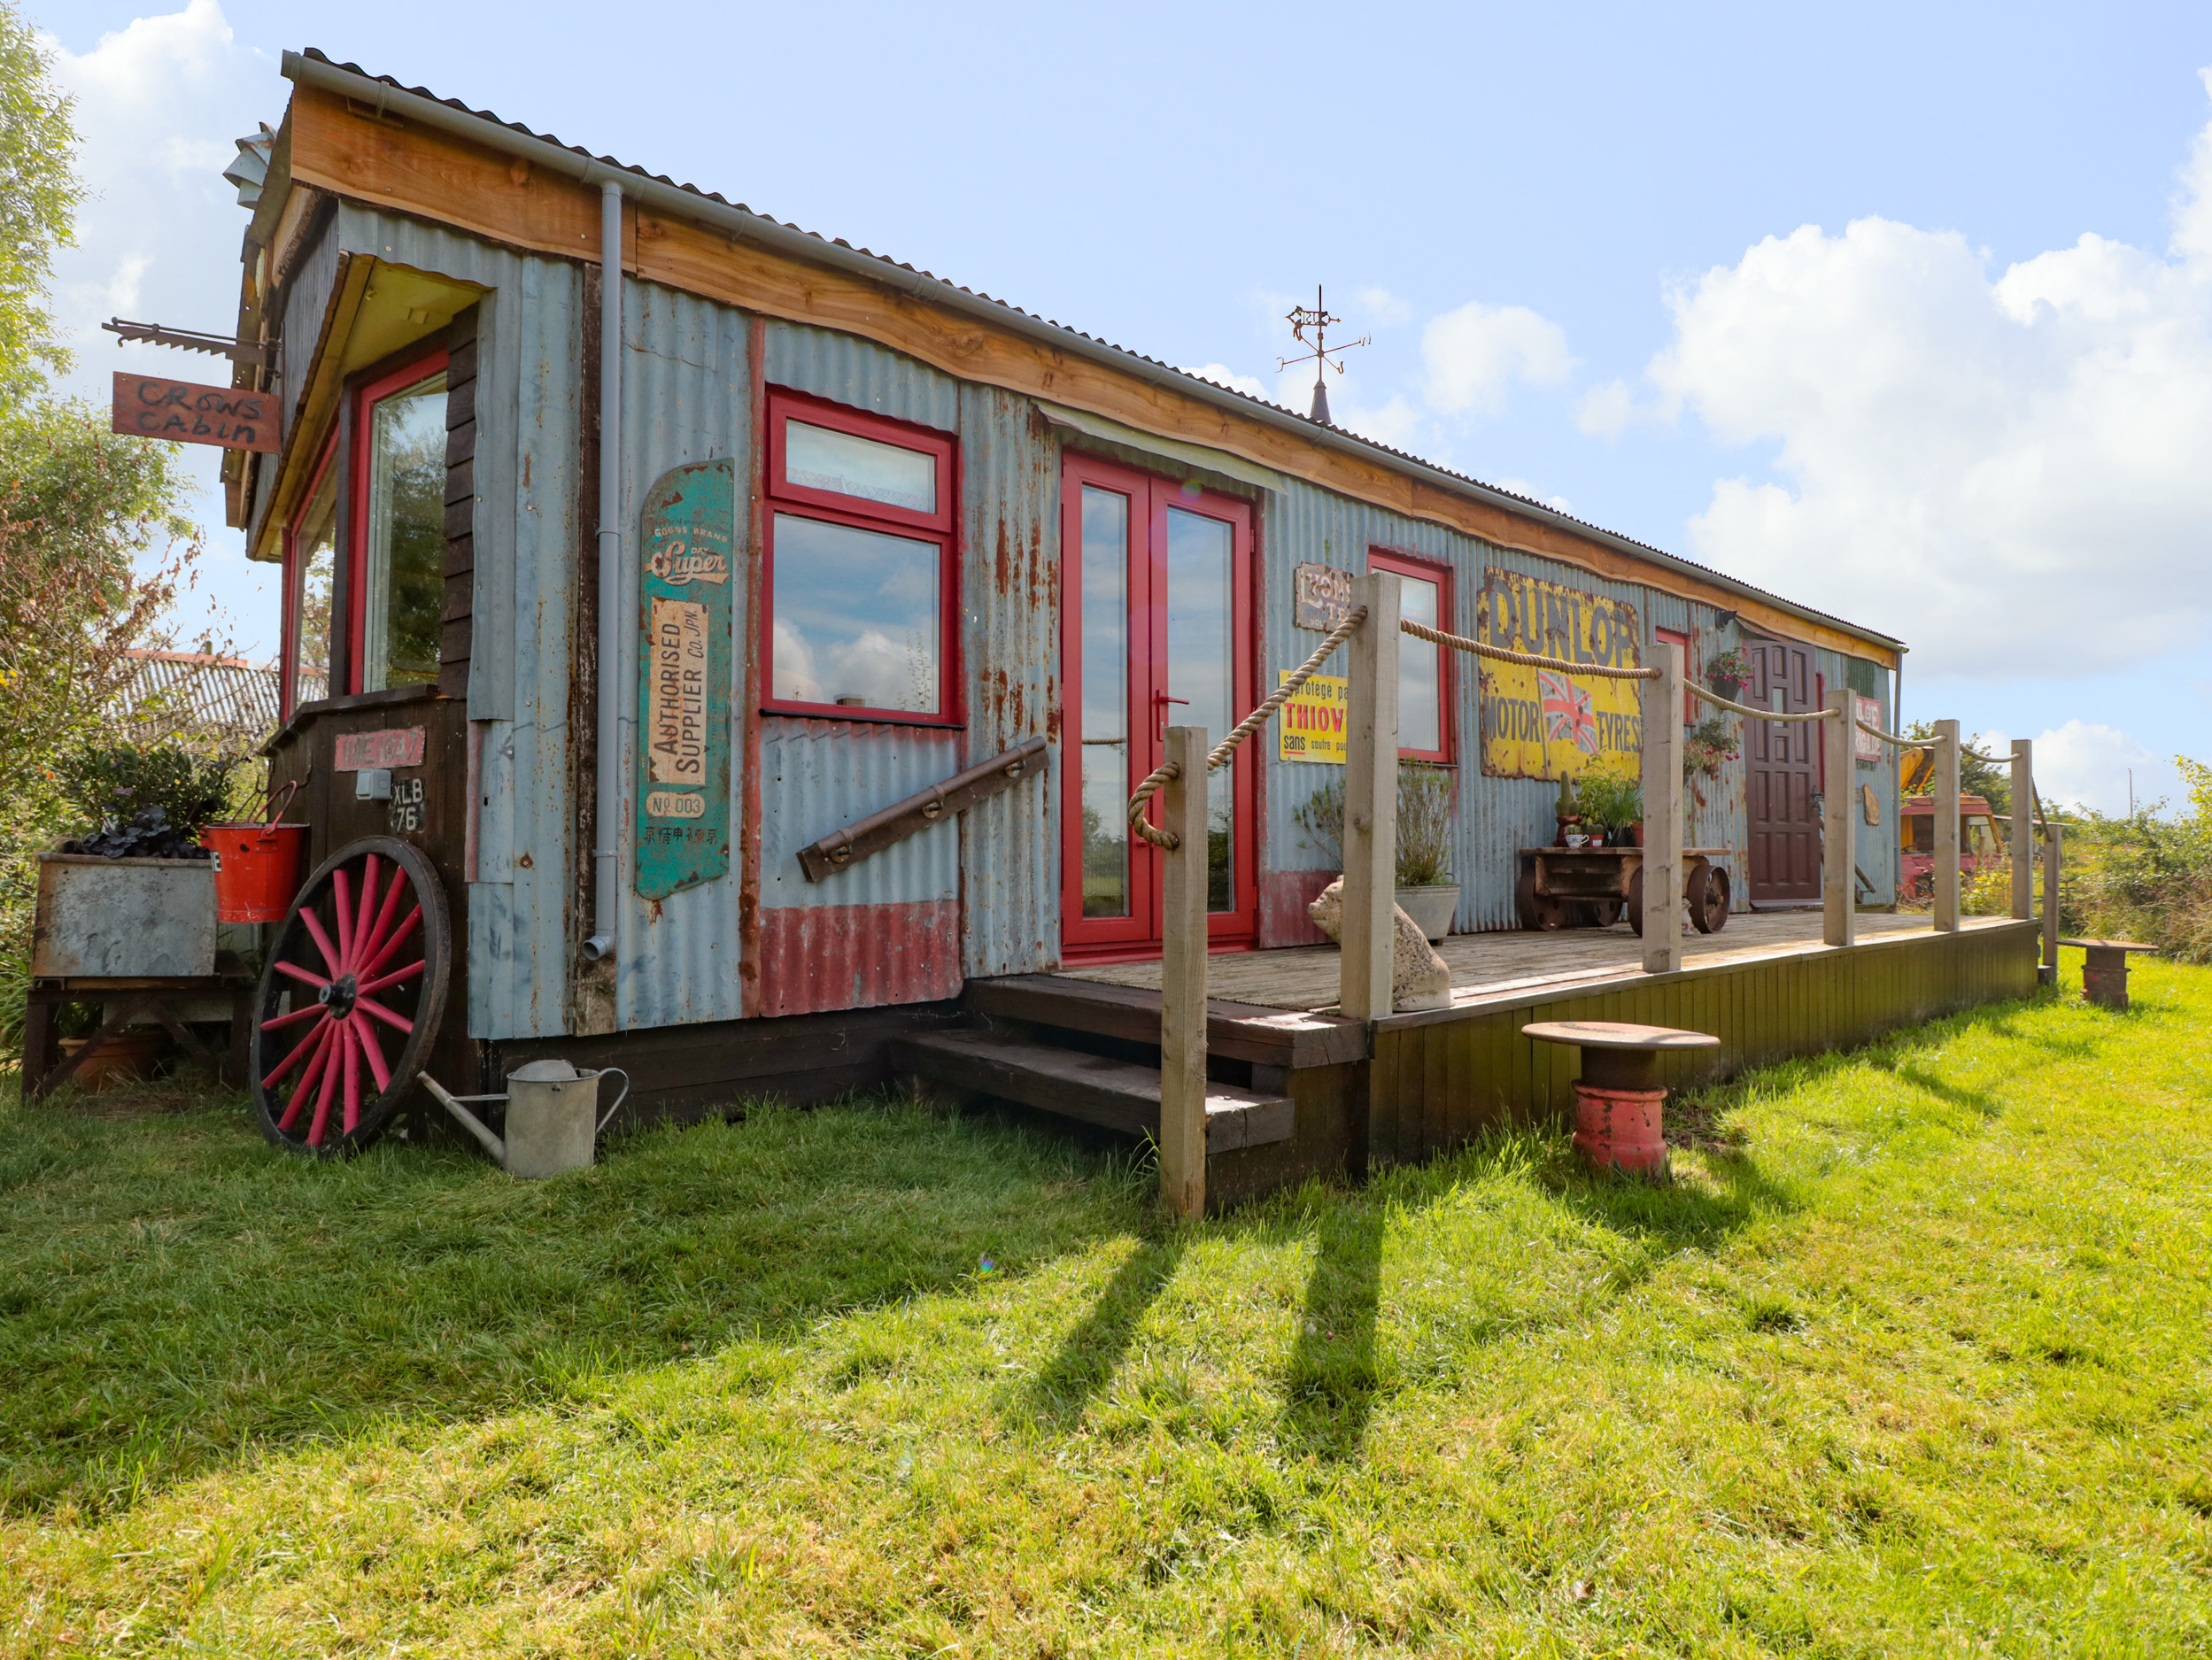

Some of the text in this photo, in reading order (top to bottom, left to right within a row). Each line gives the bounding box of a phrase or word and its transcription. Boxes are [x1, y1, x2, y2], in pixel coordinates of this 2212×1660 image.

[693, 528, 728, 543] BRAND
[645, 540, 730, 586] Super
[1488, 579, 1633, 668] DUNLOP
[654, 623, 682, 755] AUTHORISED
[676, 669, 703, 775] SUPPLIER
[1284, 703, 1348, 733] THIOV
[1482, 695, 1640, 753] MOTOR TYRES
[1284, 735, 1306, 751] sans
[1311, 738, 1331, 751] soufre
[393, 778, 423, 806] XLB
[676, 798, 700, 814] 003
[396, 807, 417, 831] 76
